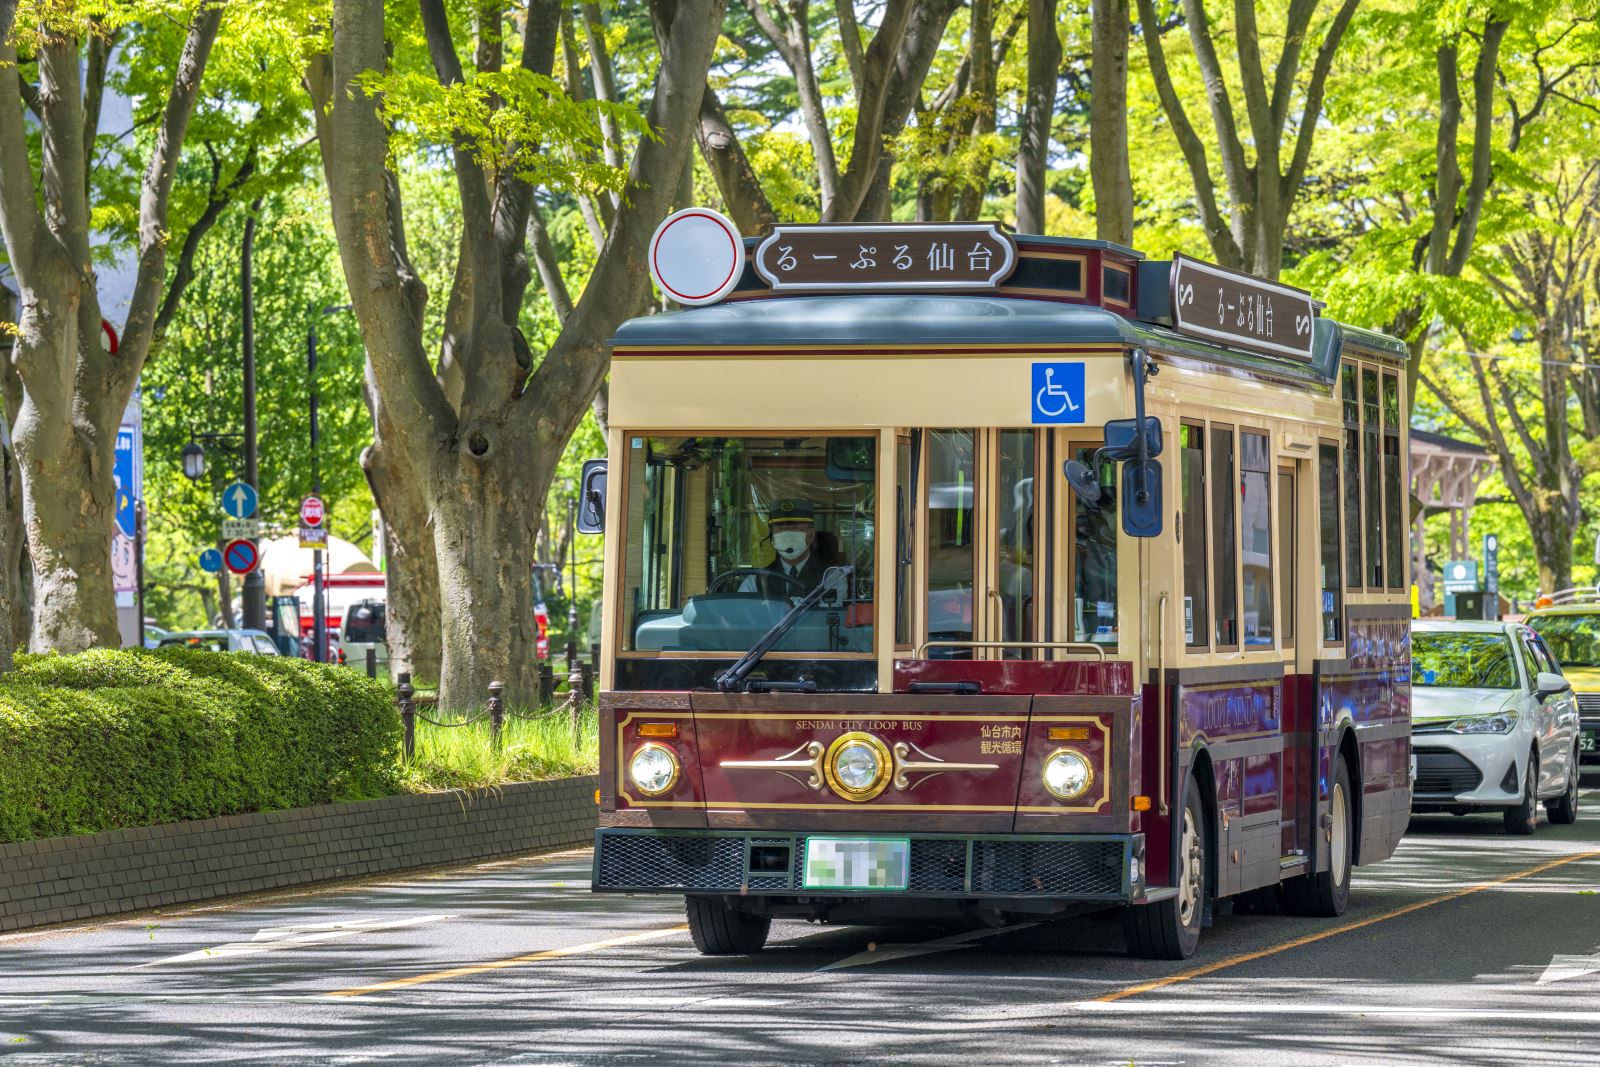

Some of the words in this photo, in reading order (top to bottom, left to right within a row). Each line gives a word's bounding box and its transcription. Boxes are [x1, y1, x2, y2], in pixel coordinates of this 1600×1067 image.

[776, 242, 993, 271] るーぷる仙台
[1218, 287, 1273, 338] るーぷる仙台
[796, 720, 834, 730] SENDAI
[839, 720, 864, 730] CITY
[869, 721, 898, 730] LOOP
[902, 722, 923, 731] BUS
[980, 724, 1022, 739] 仙台市内
